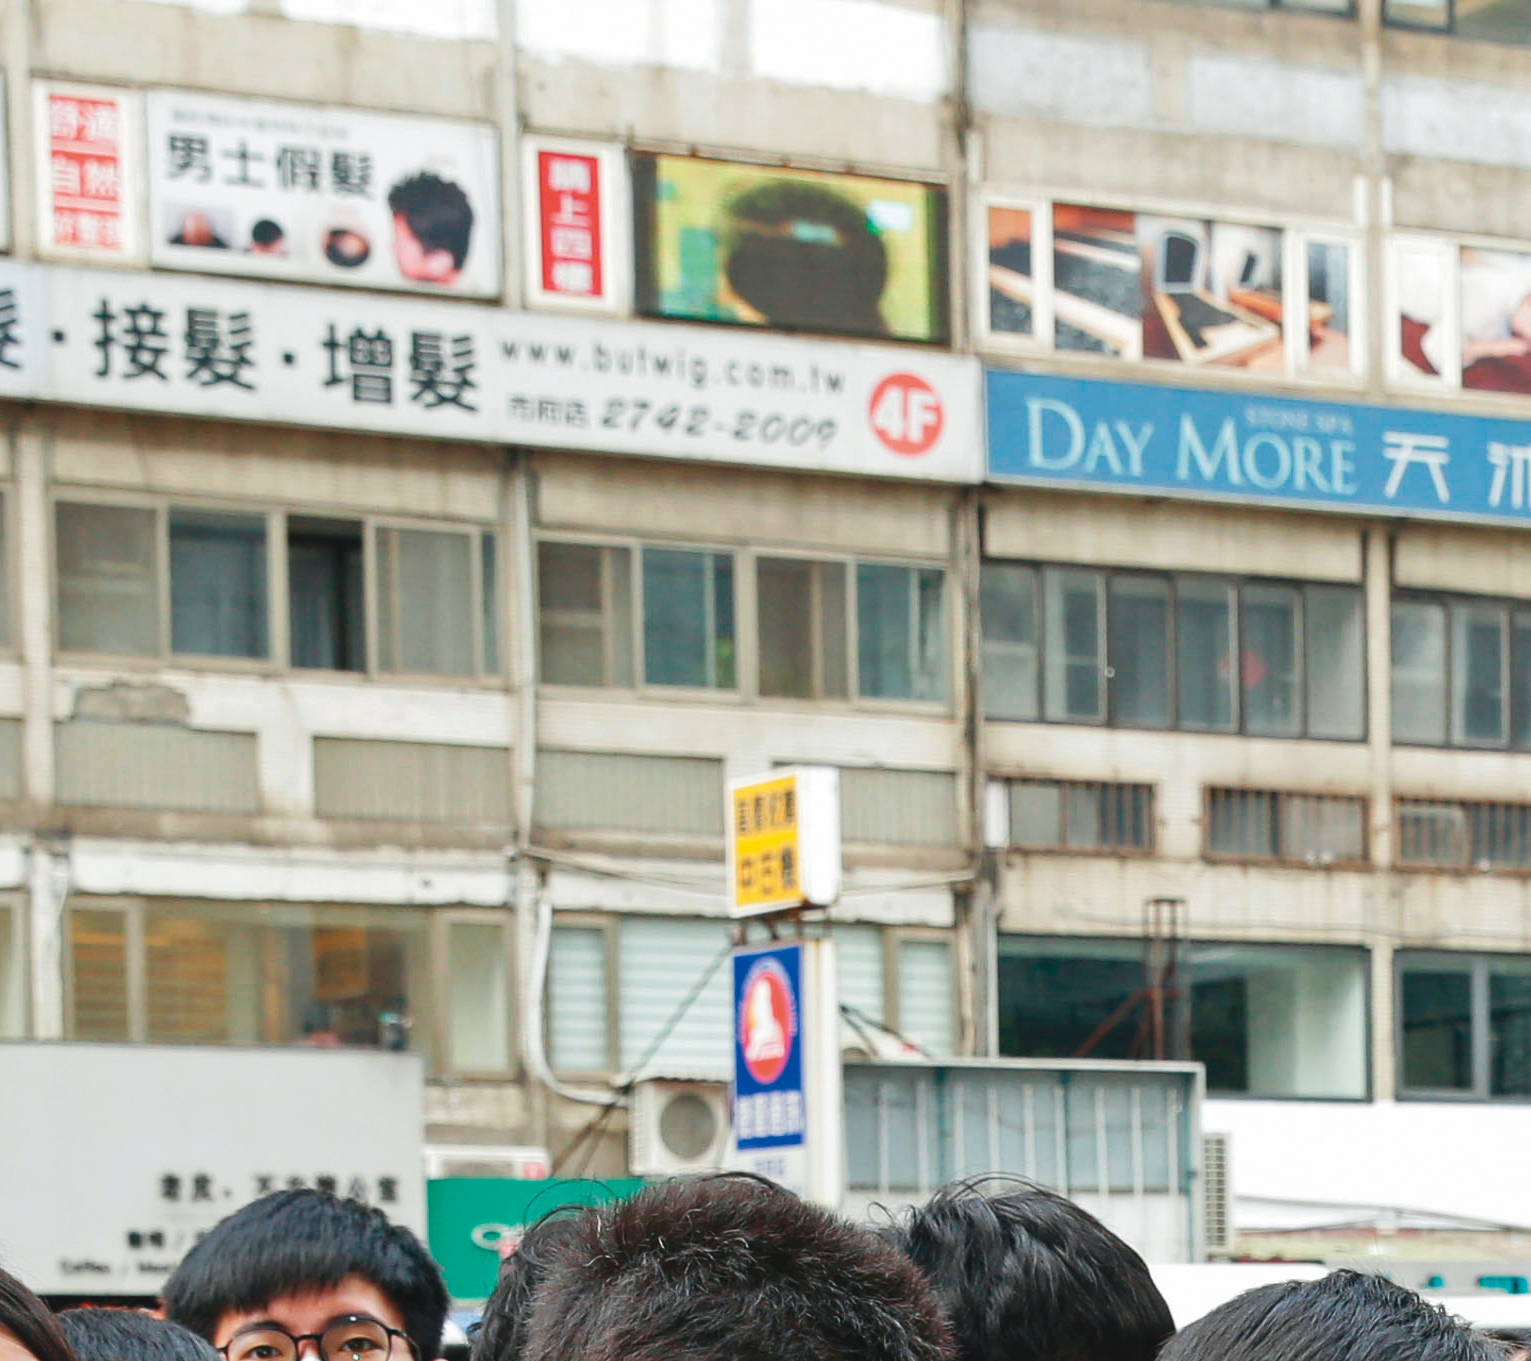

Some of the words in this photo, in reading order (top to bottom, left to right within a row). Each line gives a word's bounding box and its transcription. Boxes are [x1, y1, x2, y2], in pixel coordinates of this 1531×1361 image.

[168, 133, 373, 197] 男士假髮
[602, 400, 839, 446] 2742-2009
[873, 388, 941, 445] 4F
[1026, 398, 1154, 476] DAY
[1176, 416, 1356, 495] MORE
